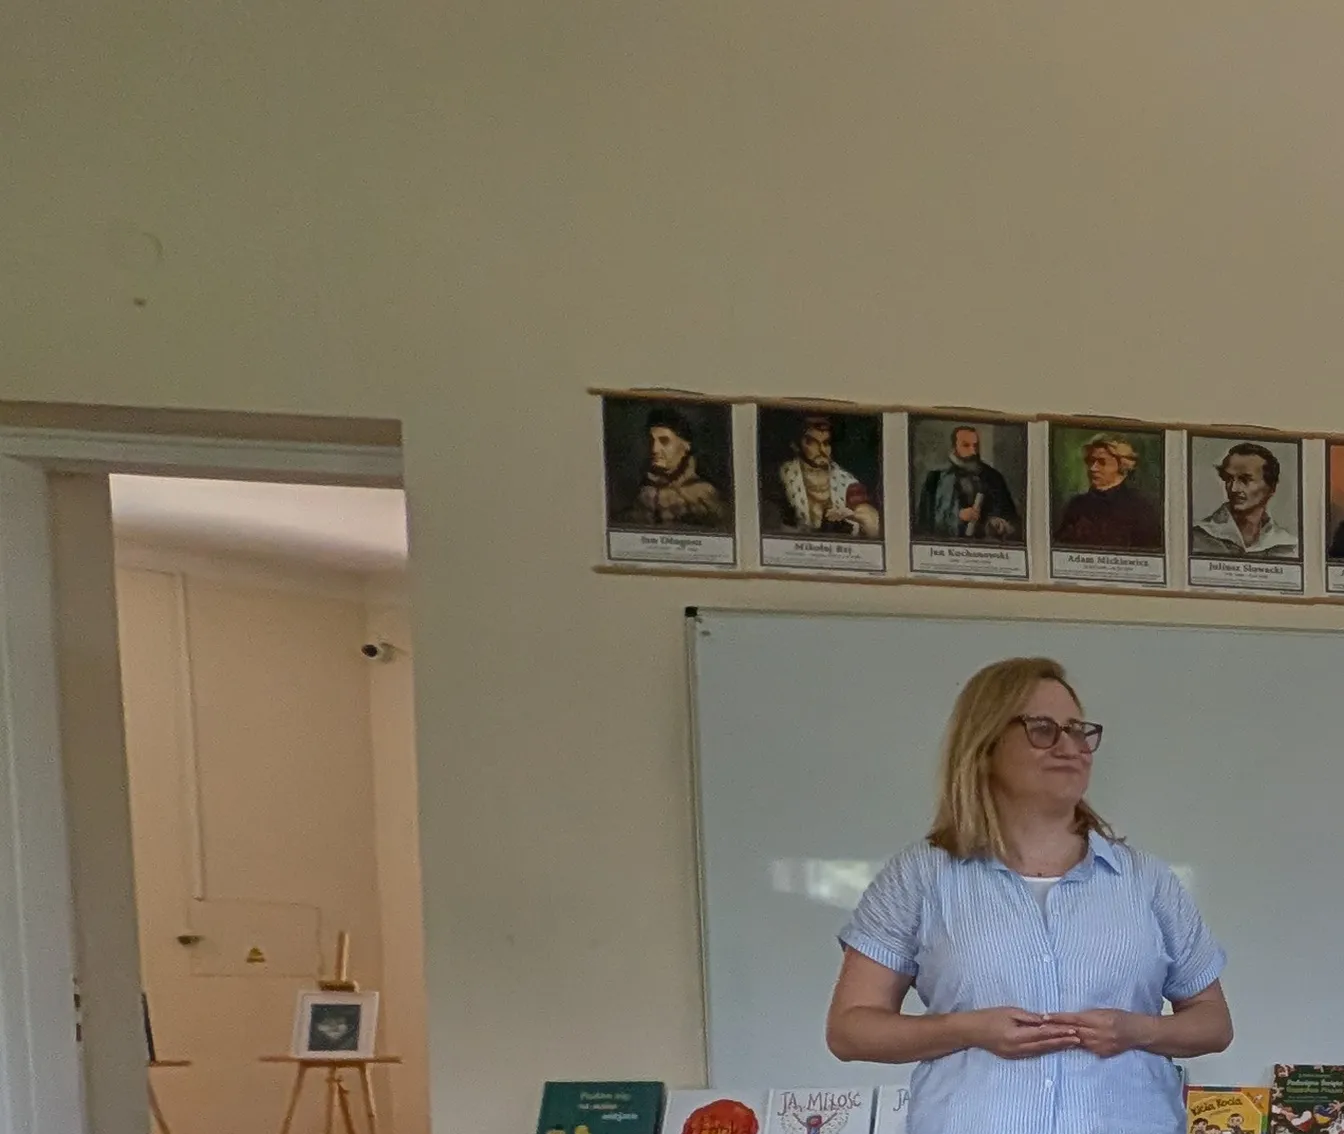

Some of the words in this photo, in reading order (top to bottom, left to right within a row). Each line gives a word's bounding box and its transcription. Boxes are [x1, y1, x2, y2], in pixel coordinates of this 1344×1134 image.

[1067, 555, 1095, 564] Adam
[1096, 556, 1149, 567] Mickiewicz
[1208, 561, 1241, 572] Juliusz
